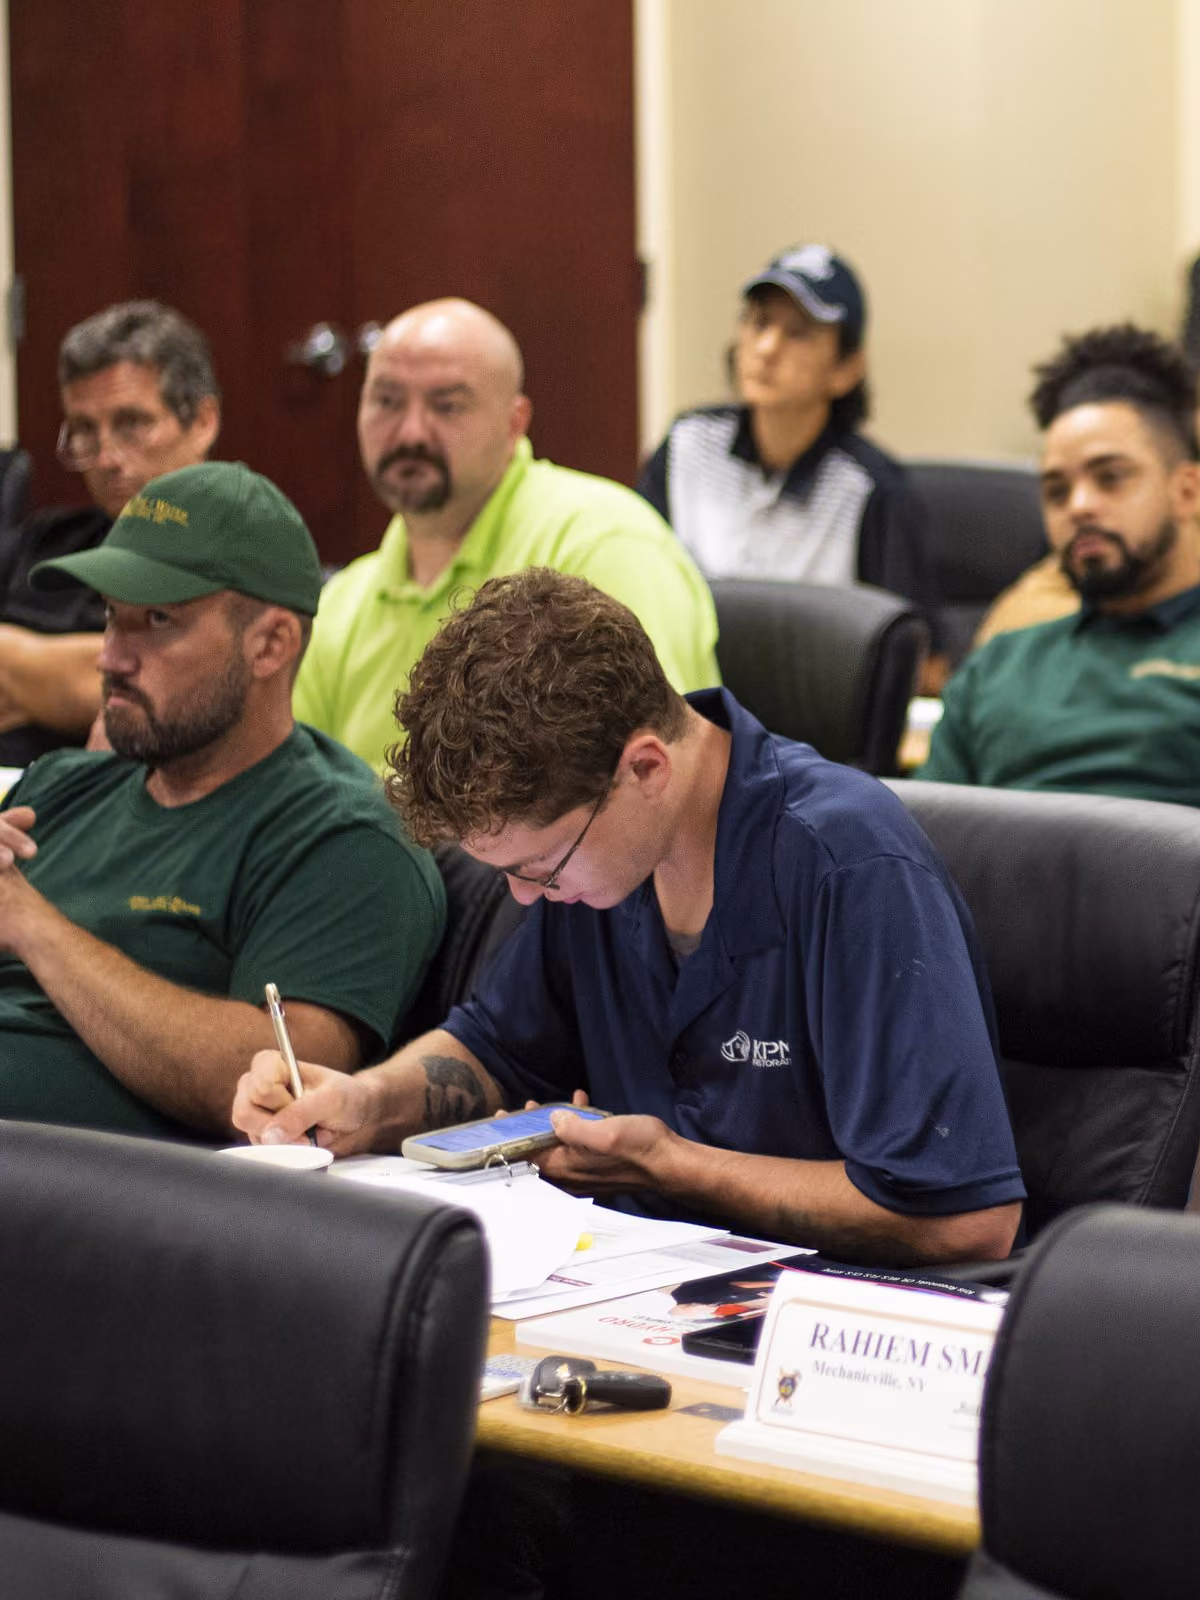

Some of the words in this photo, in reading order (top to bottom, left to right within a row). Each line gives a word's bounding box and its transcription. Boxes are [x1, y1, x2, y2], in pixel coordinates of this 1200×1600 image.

[810, 1322, 932, 1367] RAHIEM
[937, 1343, 987, 1377] SM
[907, 1376, 928, 1392] NY
